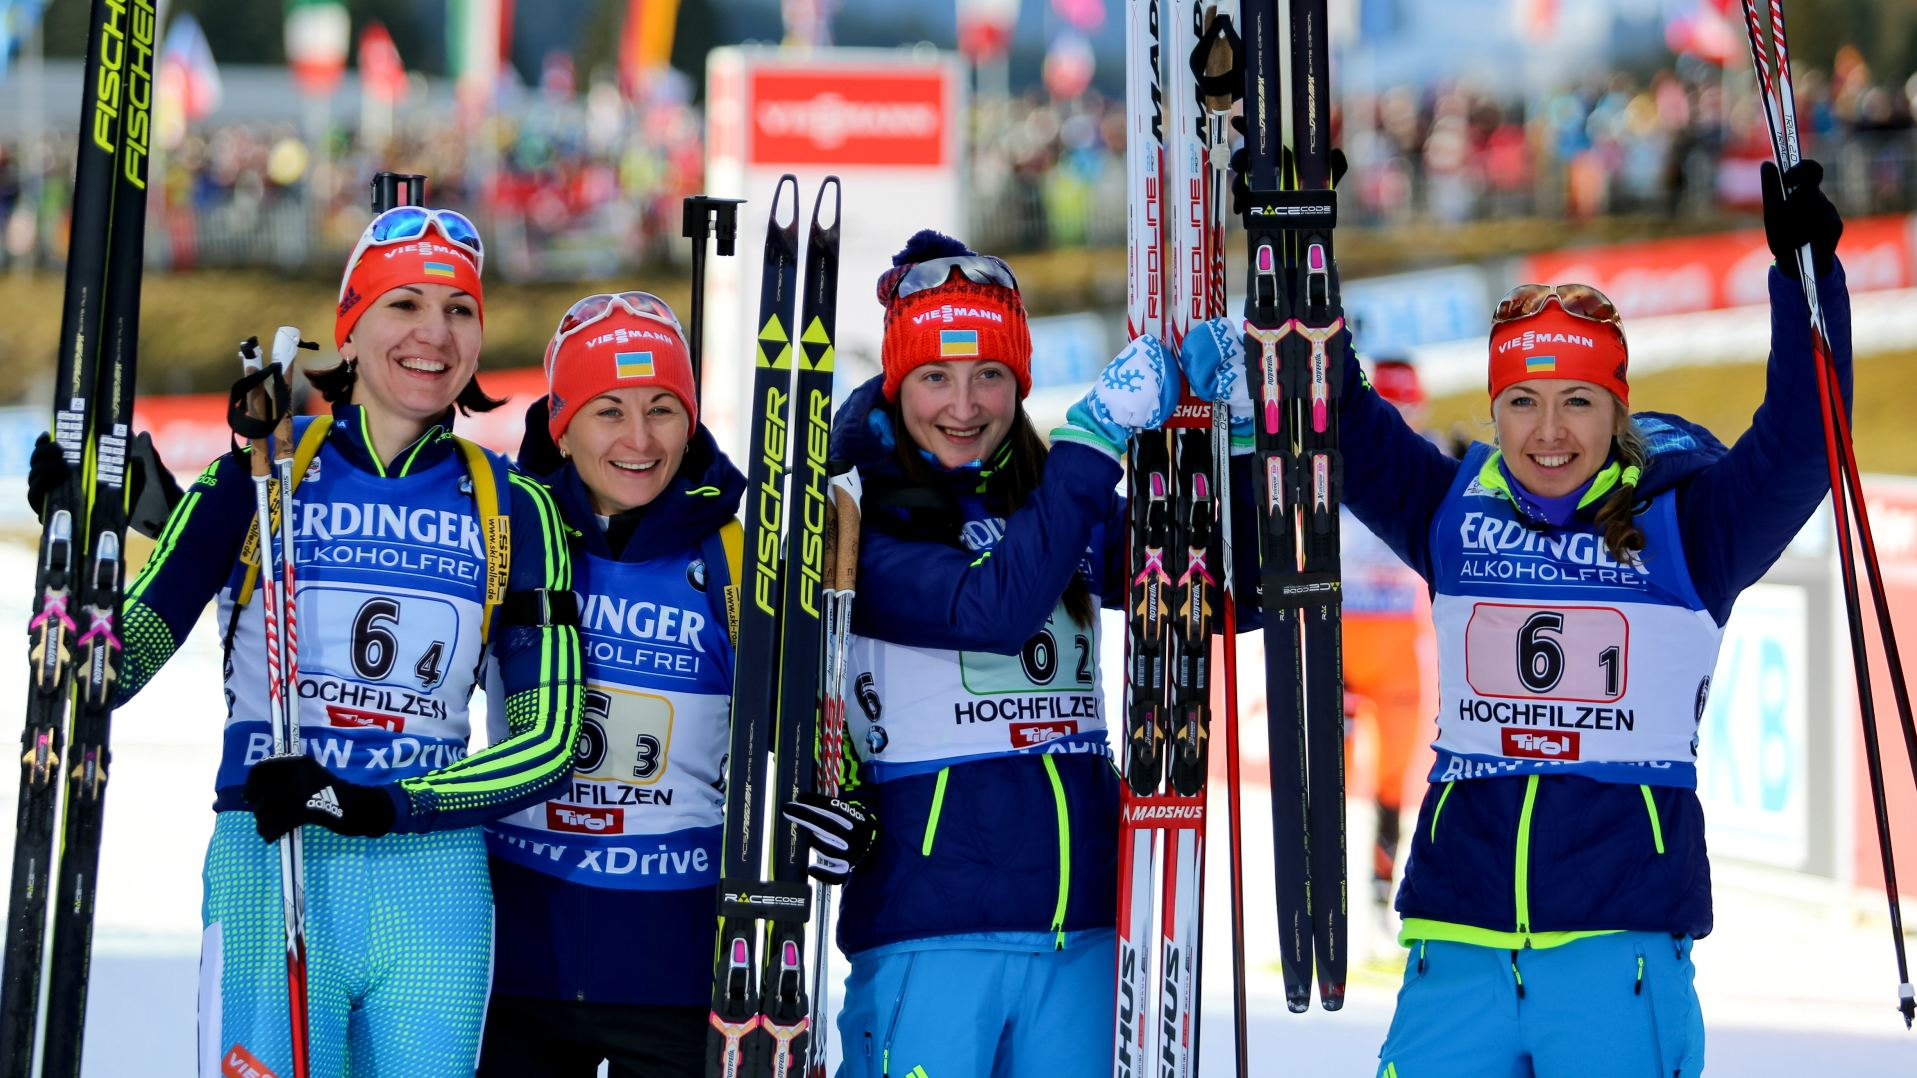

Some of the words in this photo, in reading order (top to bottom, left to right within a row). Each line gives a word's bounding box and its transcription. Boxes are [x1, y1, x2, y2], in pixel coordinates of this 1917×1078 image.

[1146, 177, 1158, 319] REDLINE
[1190, 178, 1202, 320] REDLINE
[912, 304, 1003, 325] VIESSMANN
[585, 328, 674, 349] VIESSMANN
[1498, 330, 1594, 354] VIESSMANN
[1173, 404, 1212, 418] SHUS
[755, 386, 788, 616] FISCHER
[801, 388, 830, 620] FISCHER
[1460, 560, 1648, 585] ALKOHOLFRE
[350, 595, 402, 682] 6
[413, 640, 446, 688] 4
[1516, 610, 1565, 694] 6
[1599, 645, 1620, 696] 1
[1074, 633, 1093, 685] 2
[281, 678, 448, 721] OCHFILZEN
[854, 671, 882, 723] 6
[1459, 698, 1634, 732] HOCHFILZEN
[244, 732, 354, 768] BW
[633, 733, 661, 779] 3
[1510, 733, 1570, 754] Tirol
[306, 799, 344, 819] adidas
[555, 809, 615, 830] Tirol
[830, 798, 866, 822] adidas
[1131, 805, 1204, 821] MADSHUS
[577, 844, 710, 876] xDrive
